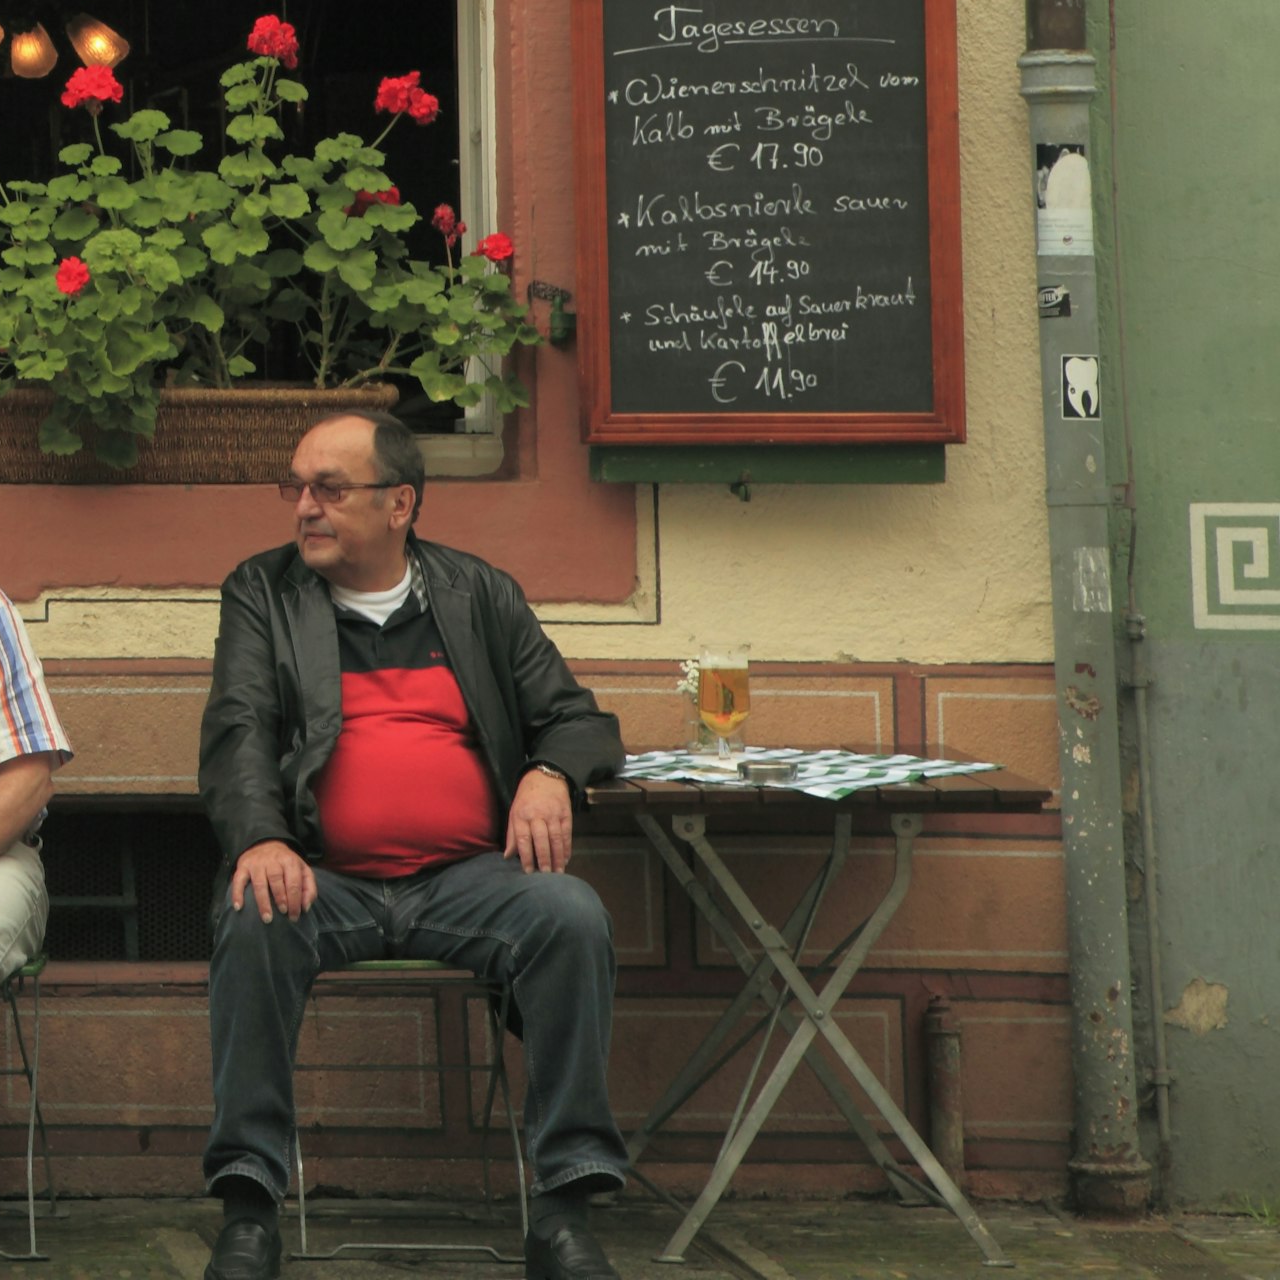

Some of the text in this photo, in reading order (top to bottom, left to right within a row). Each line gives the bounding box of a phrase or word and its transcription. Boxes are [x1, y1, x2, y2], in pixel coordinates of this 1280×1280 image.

[654, 5, 839, 53] Tagesessen
[625, 63, 919, 106] Wienerschnitzel vom
[632, 100, 873, 146] Kalb mit Brägele
[750, 143, 823, 170] 17.90
[637, 182, 908, 228] Kalbsnierle sauer
[635, 227, 811, 264] mit Brägele
[749, 260, 809, 285] 14.90
[644, 276, 916, 330] Schäufele auf Sauerkraut
[649, 321, 849, 362] und Kartoffelbrei
[754, 367, 817, 399] 11.90
